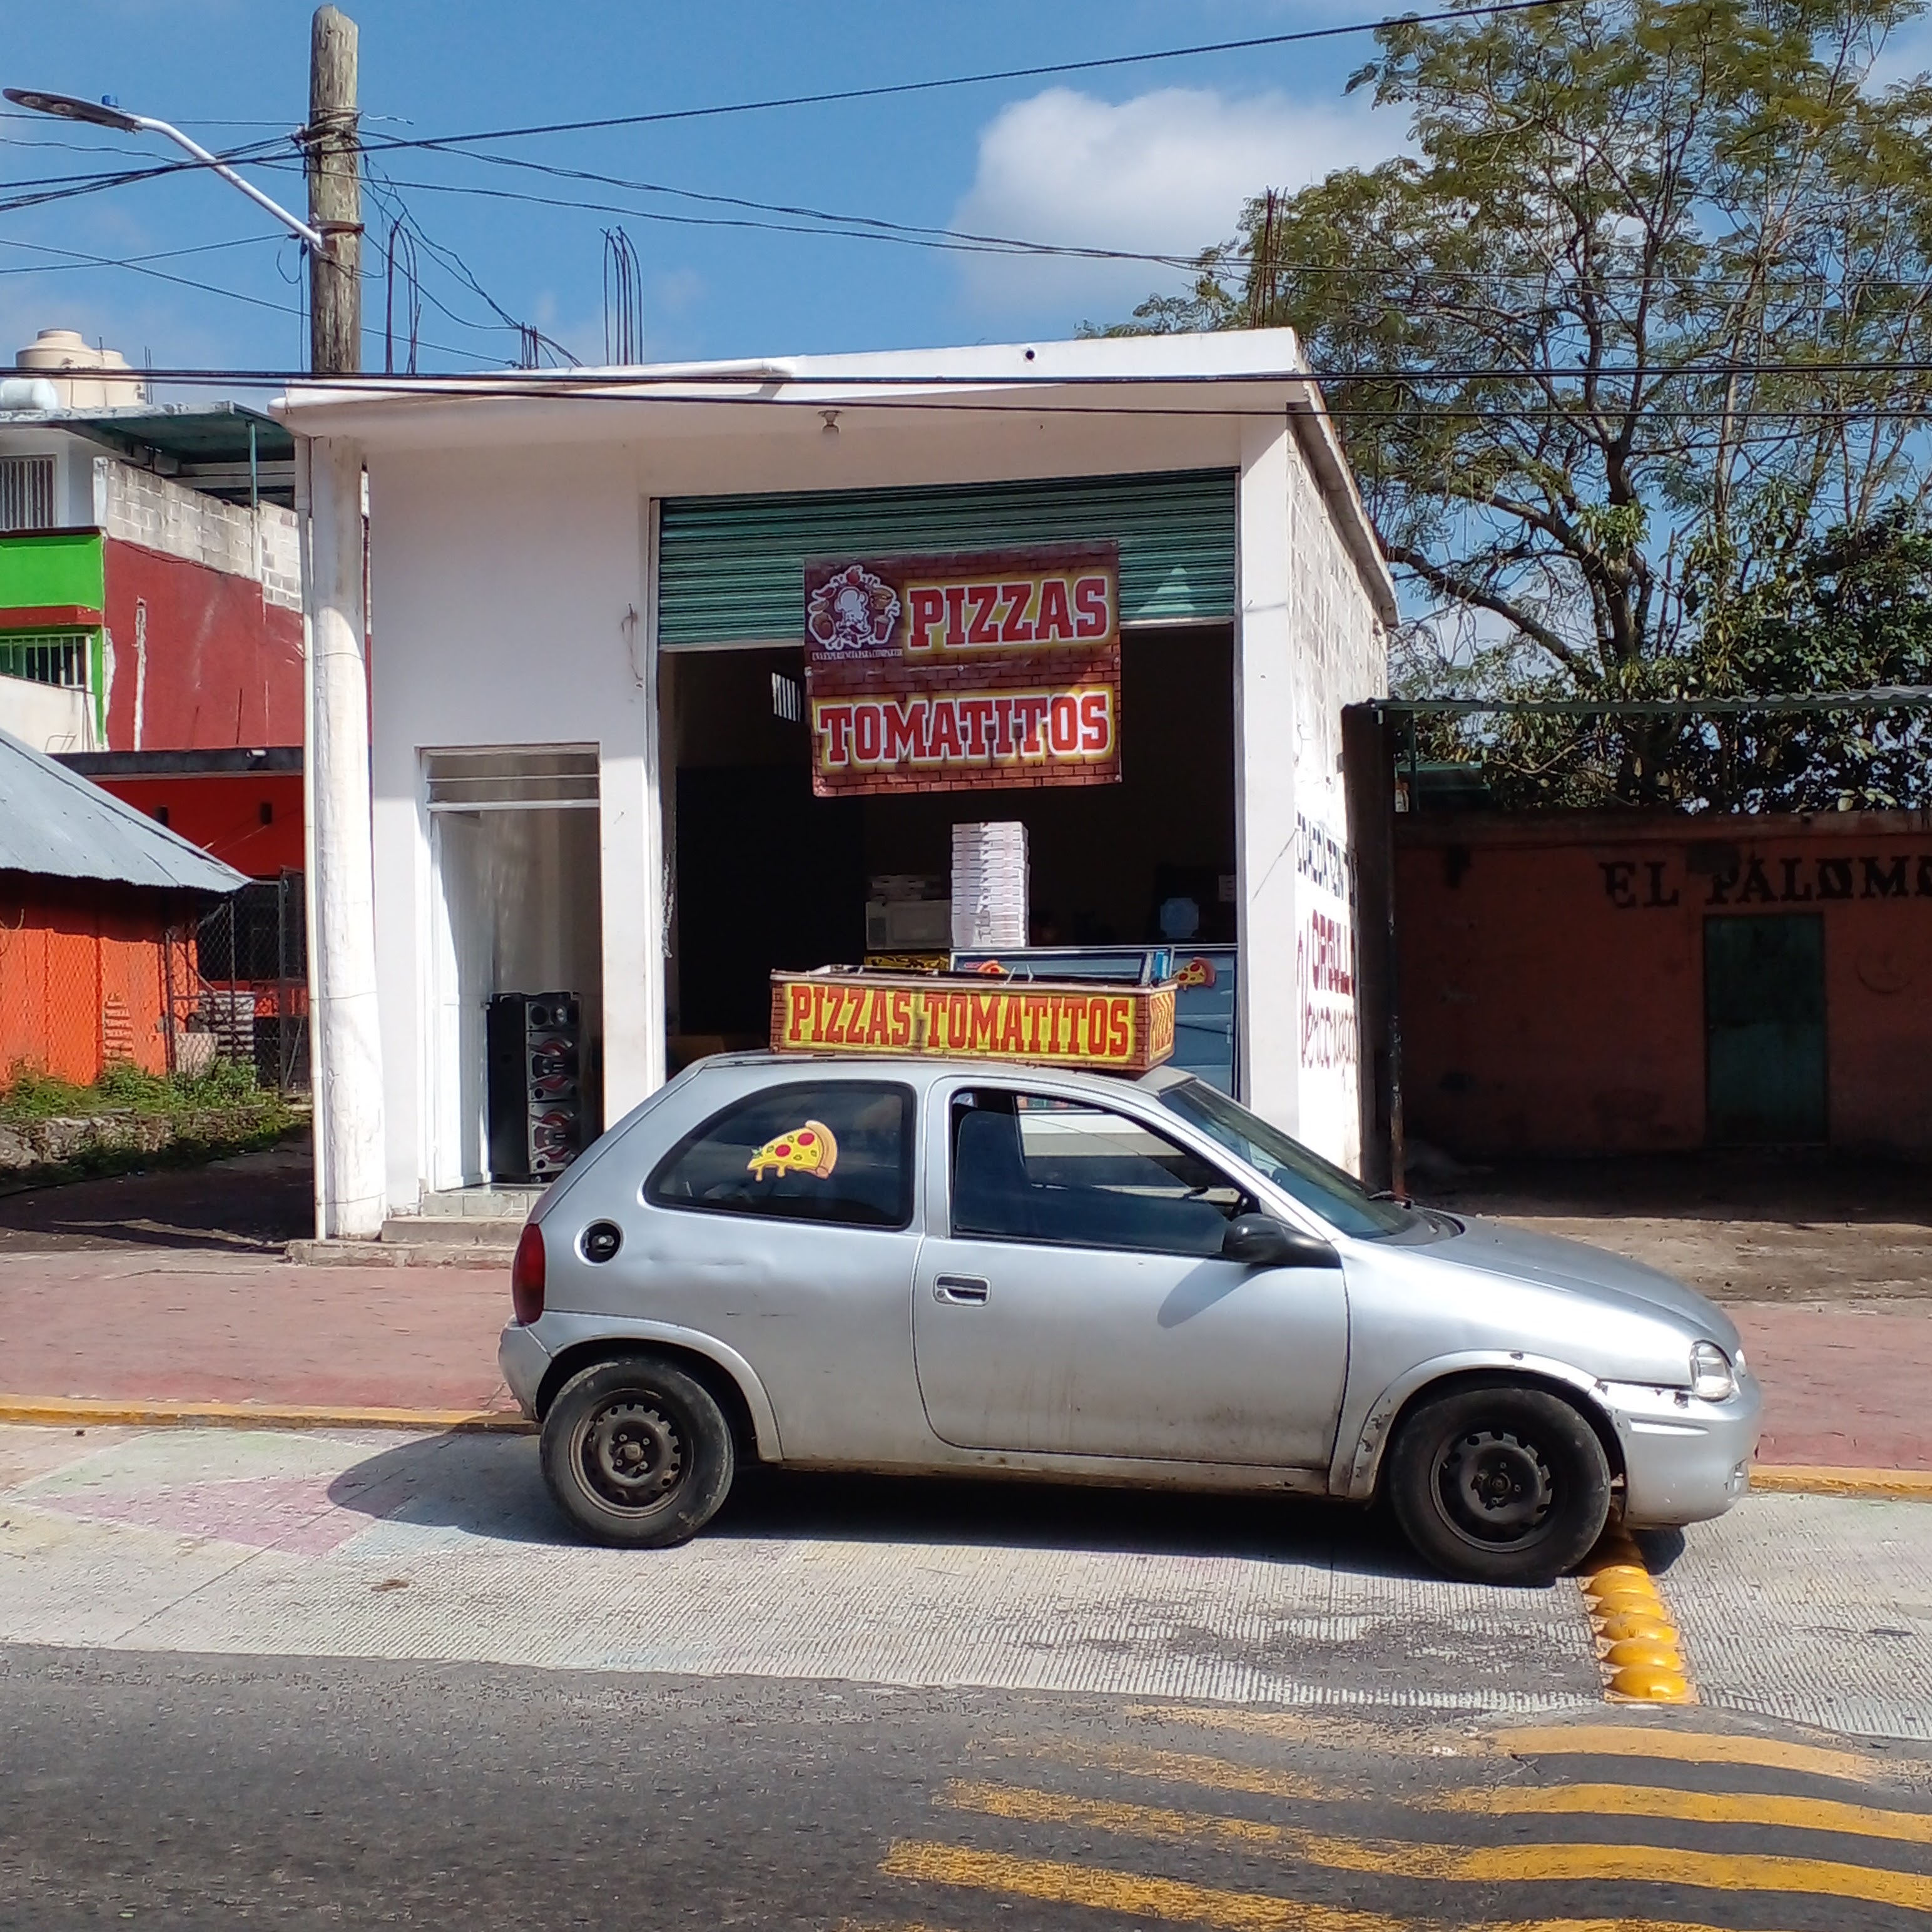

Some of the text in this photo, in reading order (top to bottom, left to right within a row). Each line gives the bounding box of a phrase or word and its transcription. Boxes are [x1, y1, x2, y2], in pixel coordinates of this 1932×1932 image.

[907, 575, 1109, 650] PIZZAS
[816, 691, 1110, 766] TOMATITOS
[1599, 861, 1680, 909] EL
[789, 985, 1130, 1057] PIZZAS TOMATITOS
